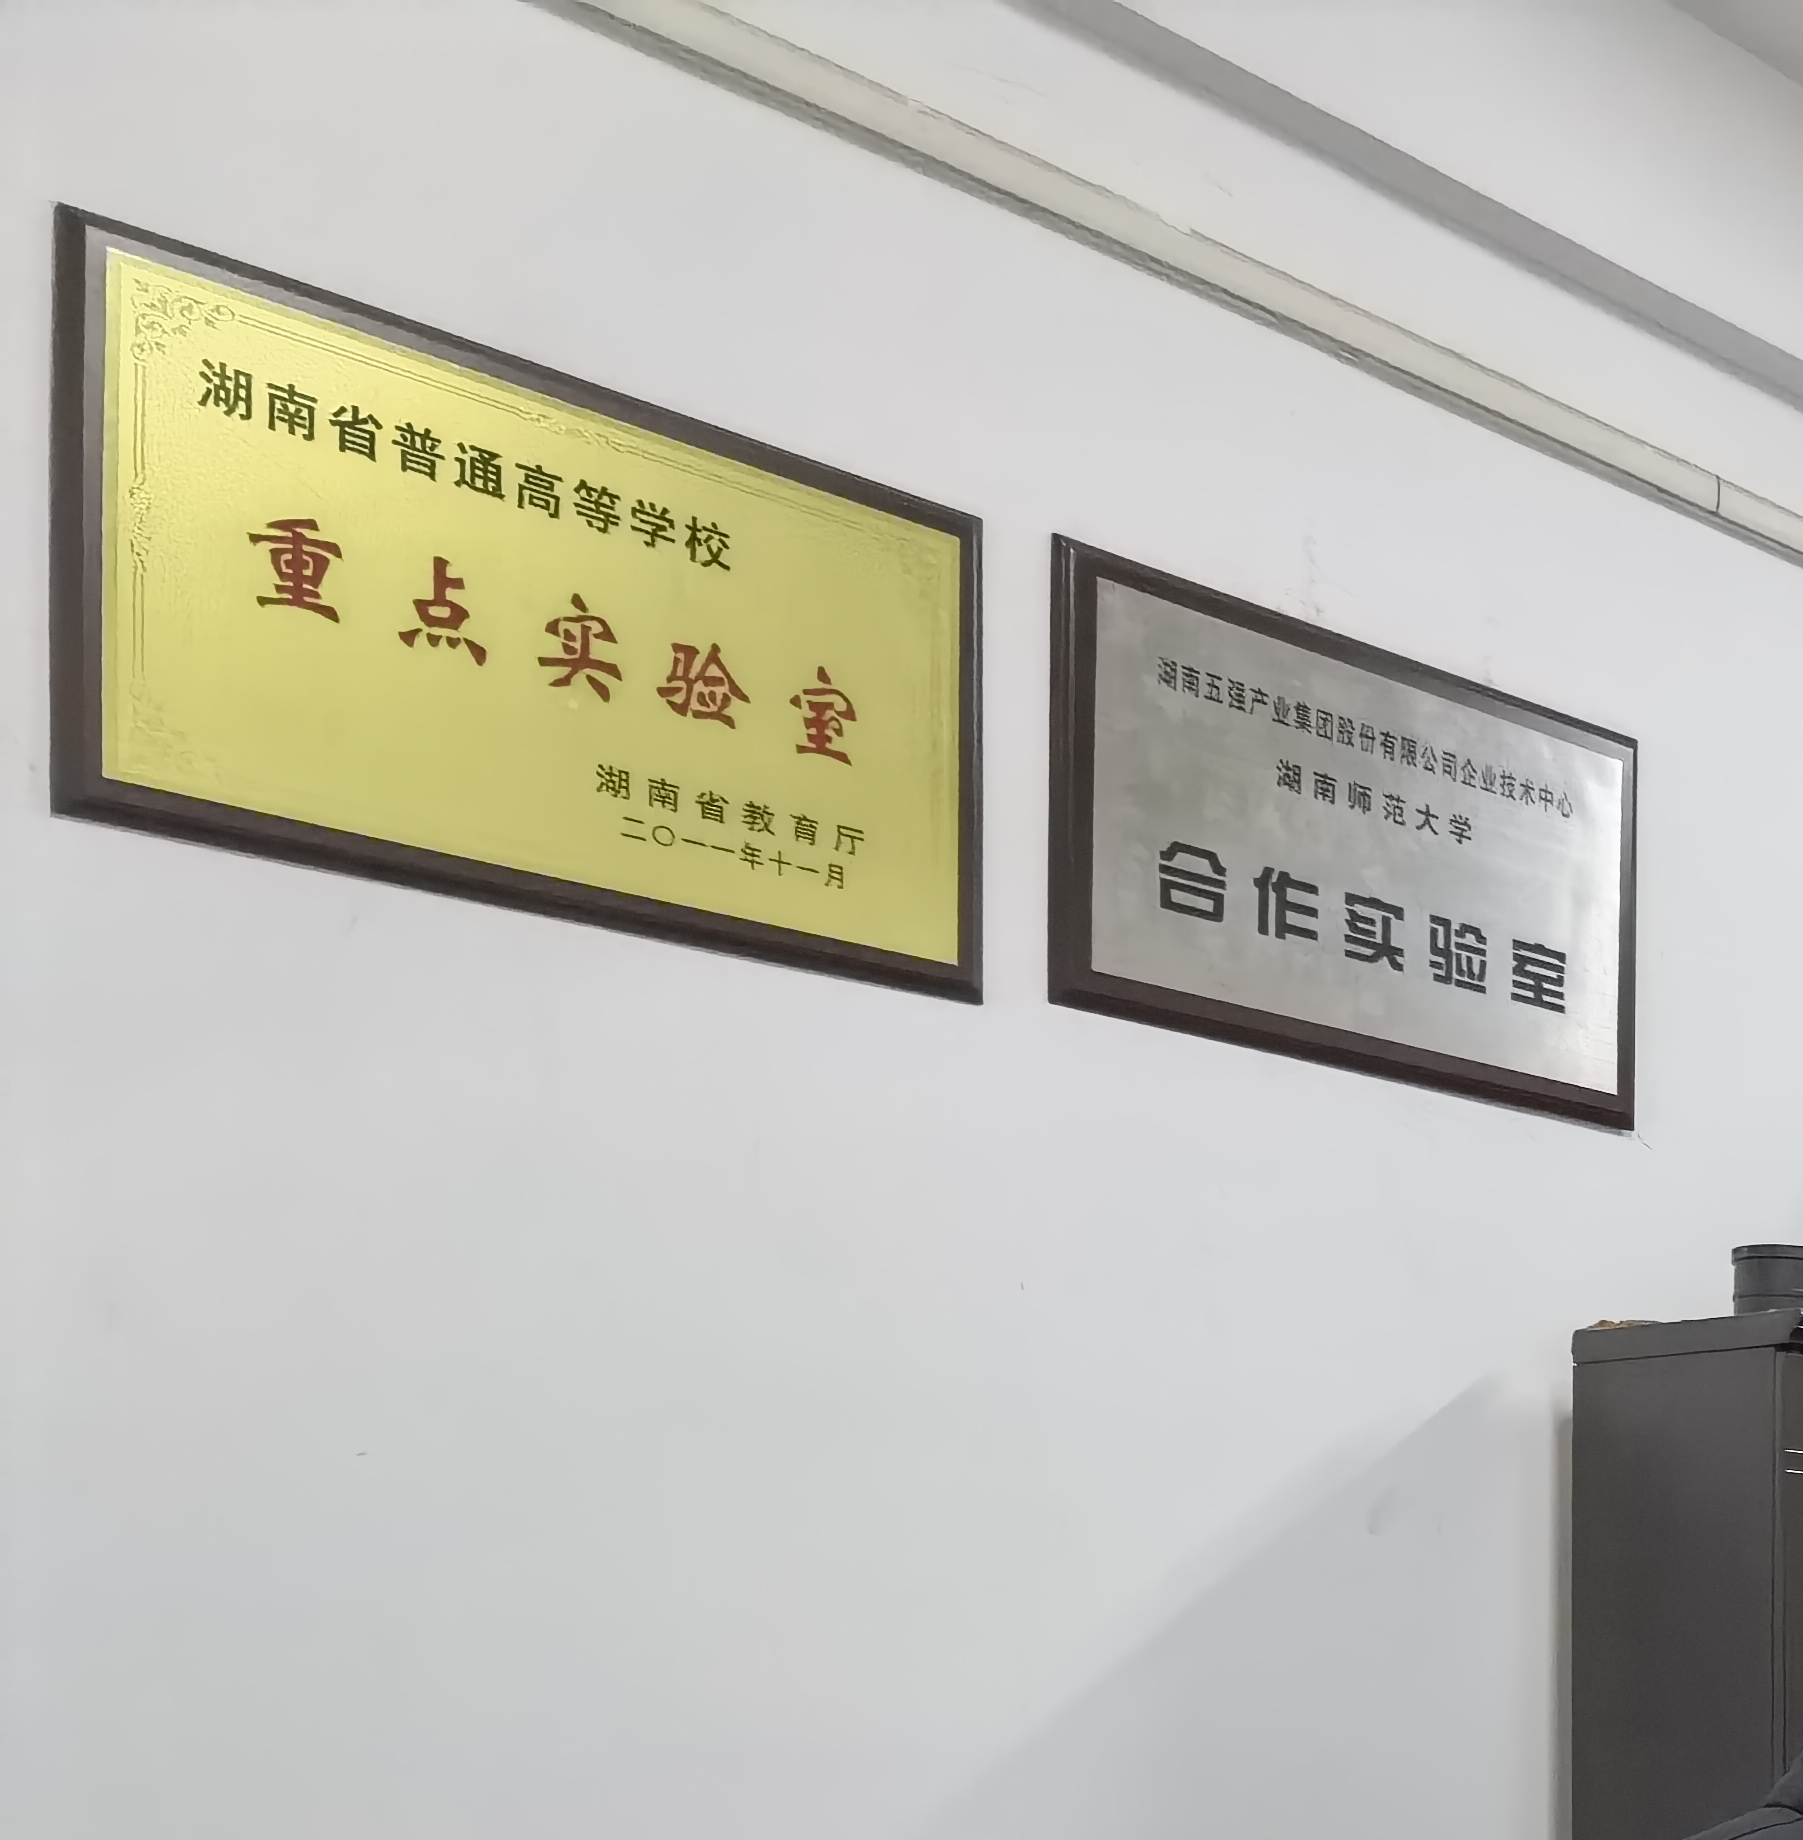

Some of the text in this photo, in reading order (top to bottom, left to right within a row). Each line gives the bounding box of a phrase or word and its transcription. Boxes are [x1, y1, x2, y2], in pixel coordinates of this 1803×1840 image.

[197, 357, 734, 573] 湖南省普通高等学校
[247, 516, 859, 767] 重点实验室
[594, 764, 867, 859] 湖南省教育厅
[1157, 655, 1574, 820] 湖南五强产业集团股份有限公司企业技术中心
[1275, 757, 1474, 846] 湖南师范大学
[1158, 840, 1567, 1015] 合作实验室
